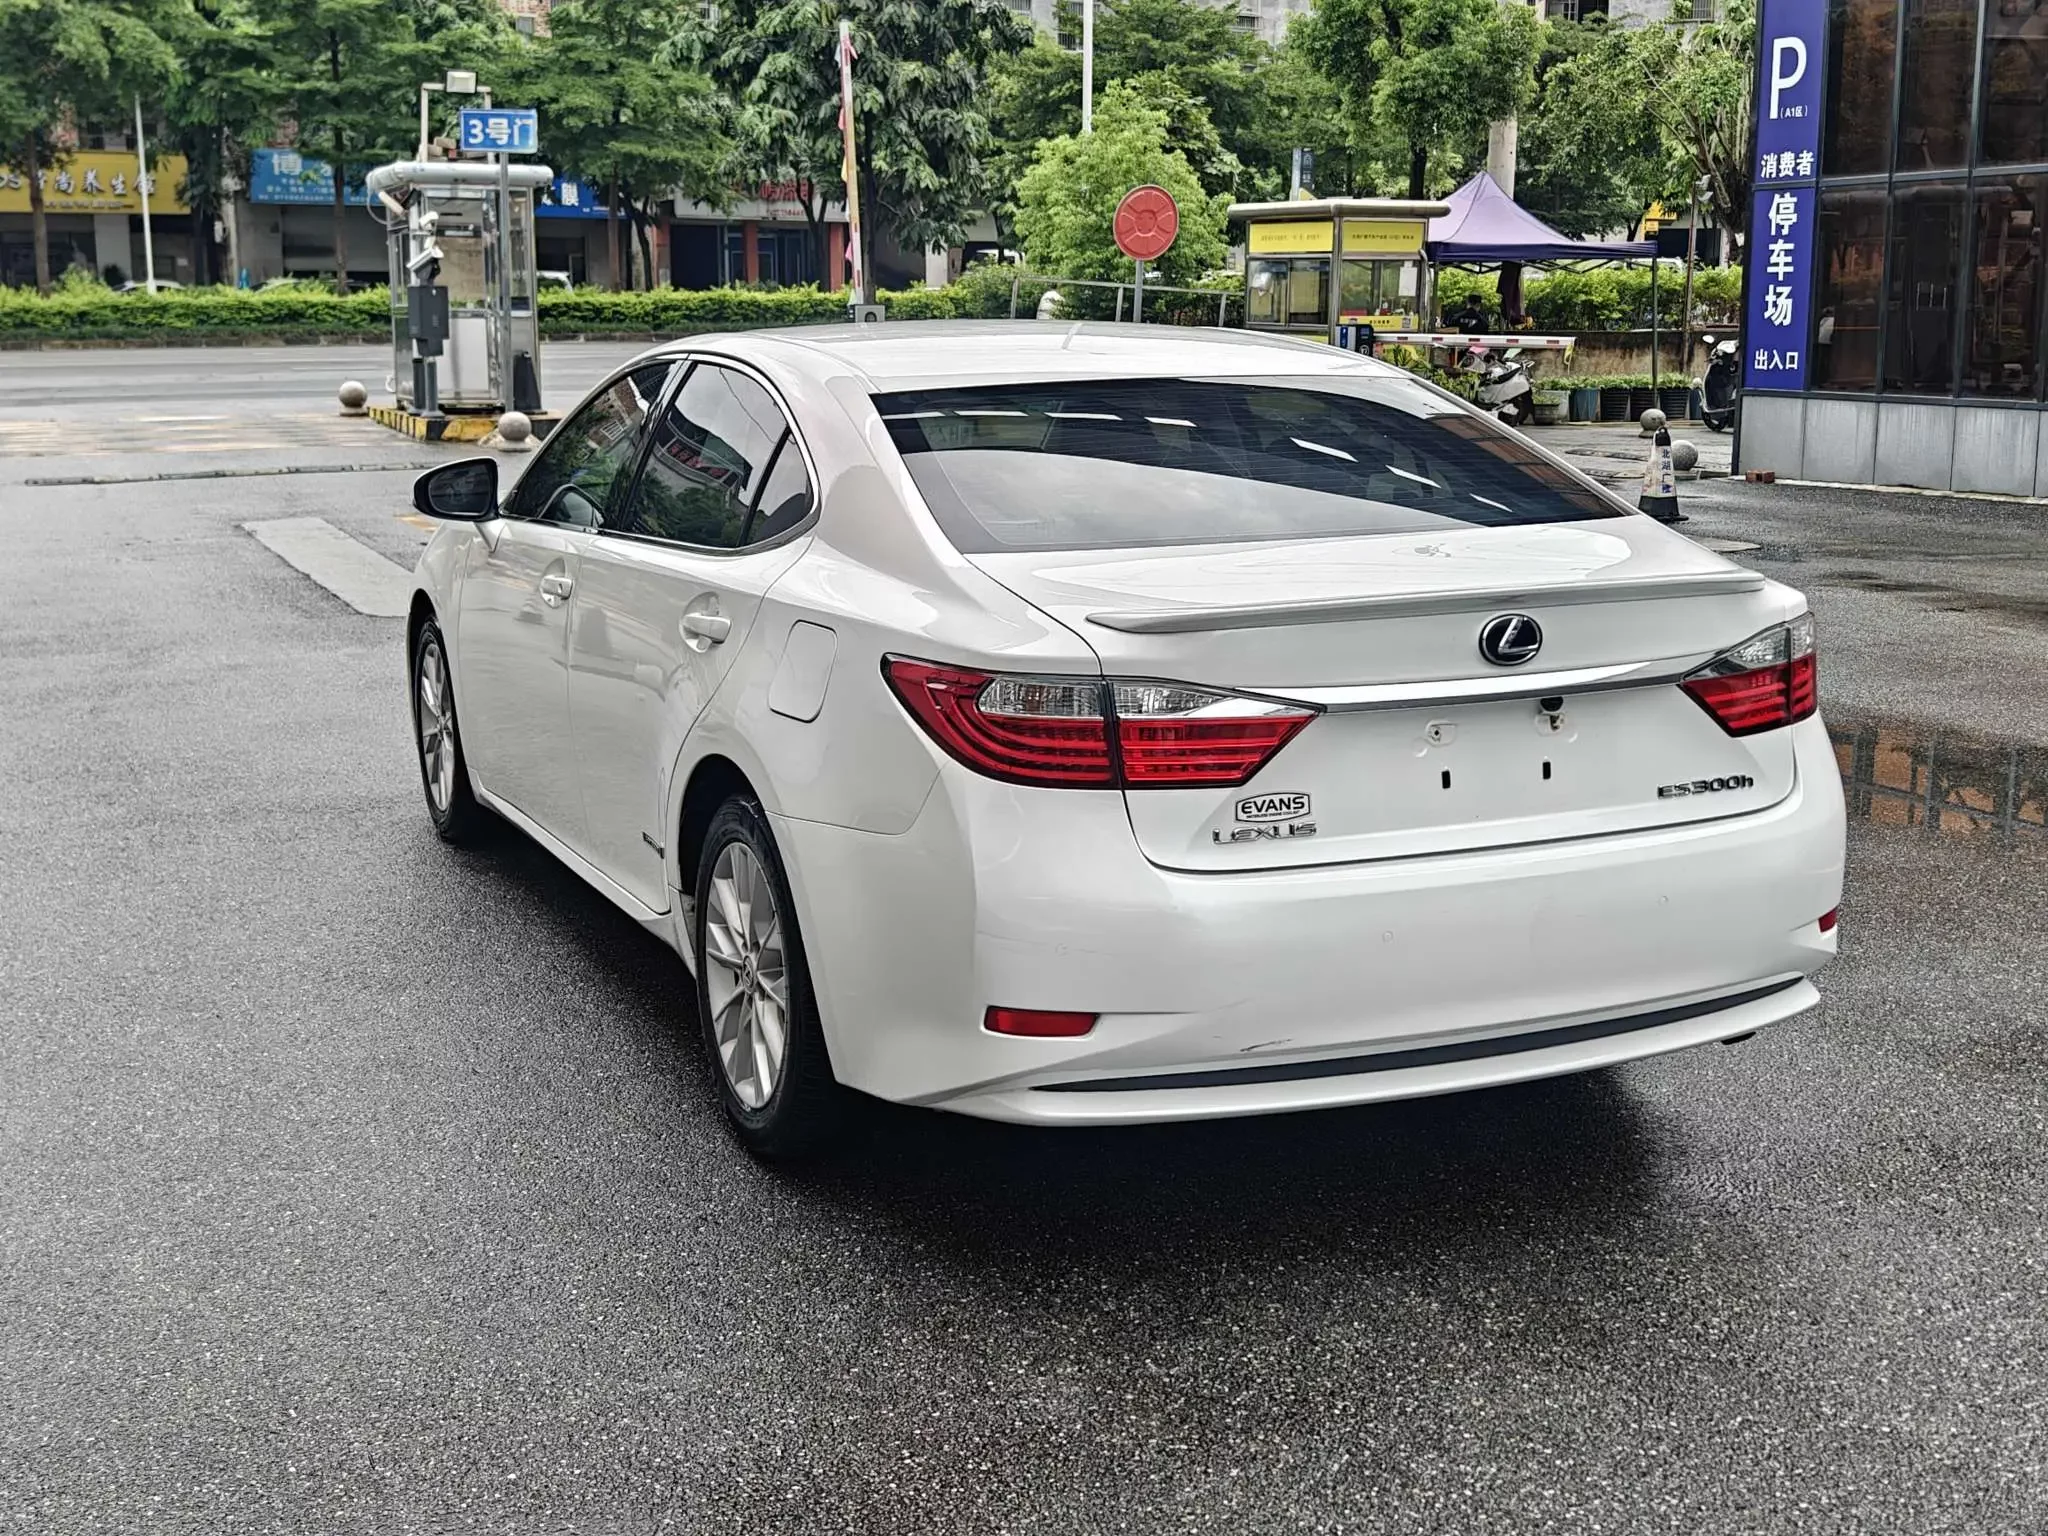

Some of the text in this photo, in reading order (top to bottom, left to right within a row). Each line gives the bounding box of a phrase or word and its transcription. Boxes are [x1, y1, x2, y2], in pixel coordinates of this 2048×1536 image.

[1769, 36, 1808, 120] P
[468, 117, 534, 146] 3号门
[1760, 150, 1815, 179] 消费者
[1763, 191, 1799, 327] 停车场
[1753, 348, 1799, 371] 出入口
[1656, 774, 1754, 799] ES300h
[1241, 796, 1306, 815] EVANS
[1212, 822, 1317, 845] LEXUS
